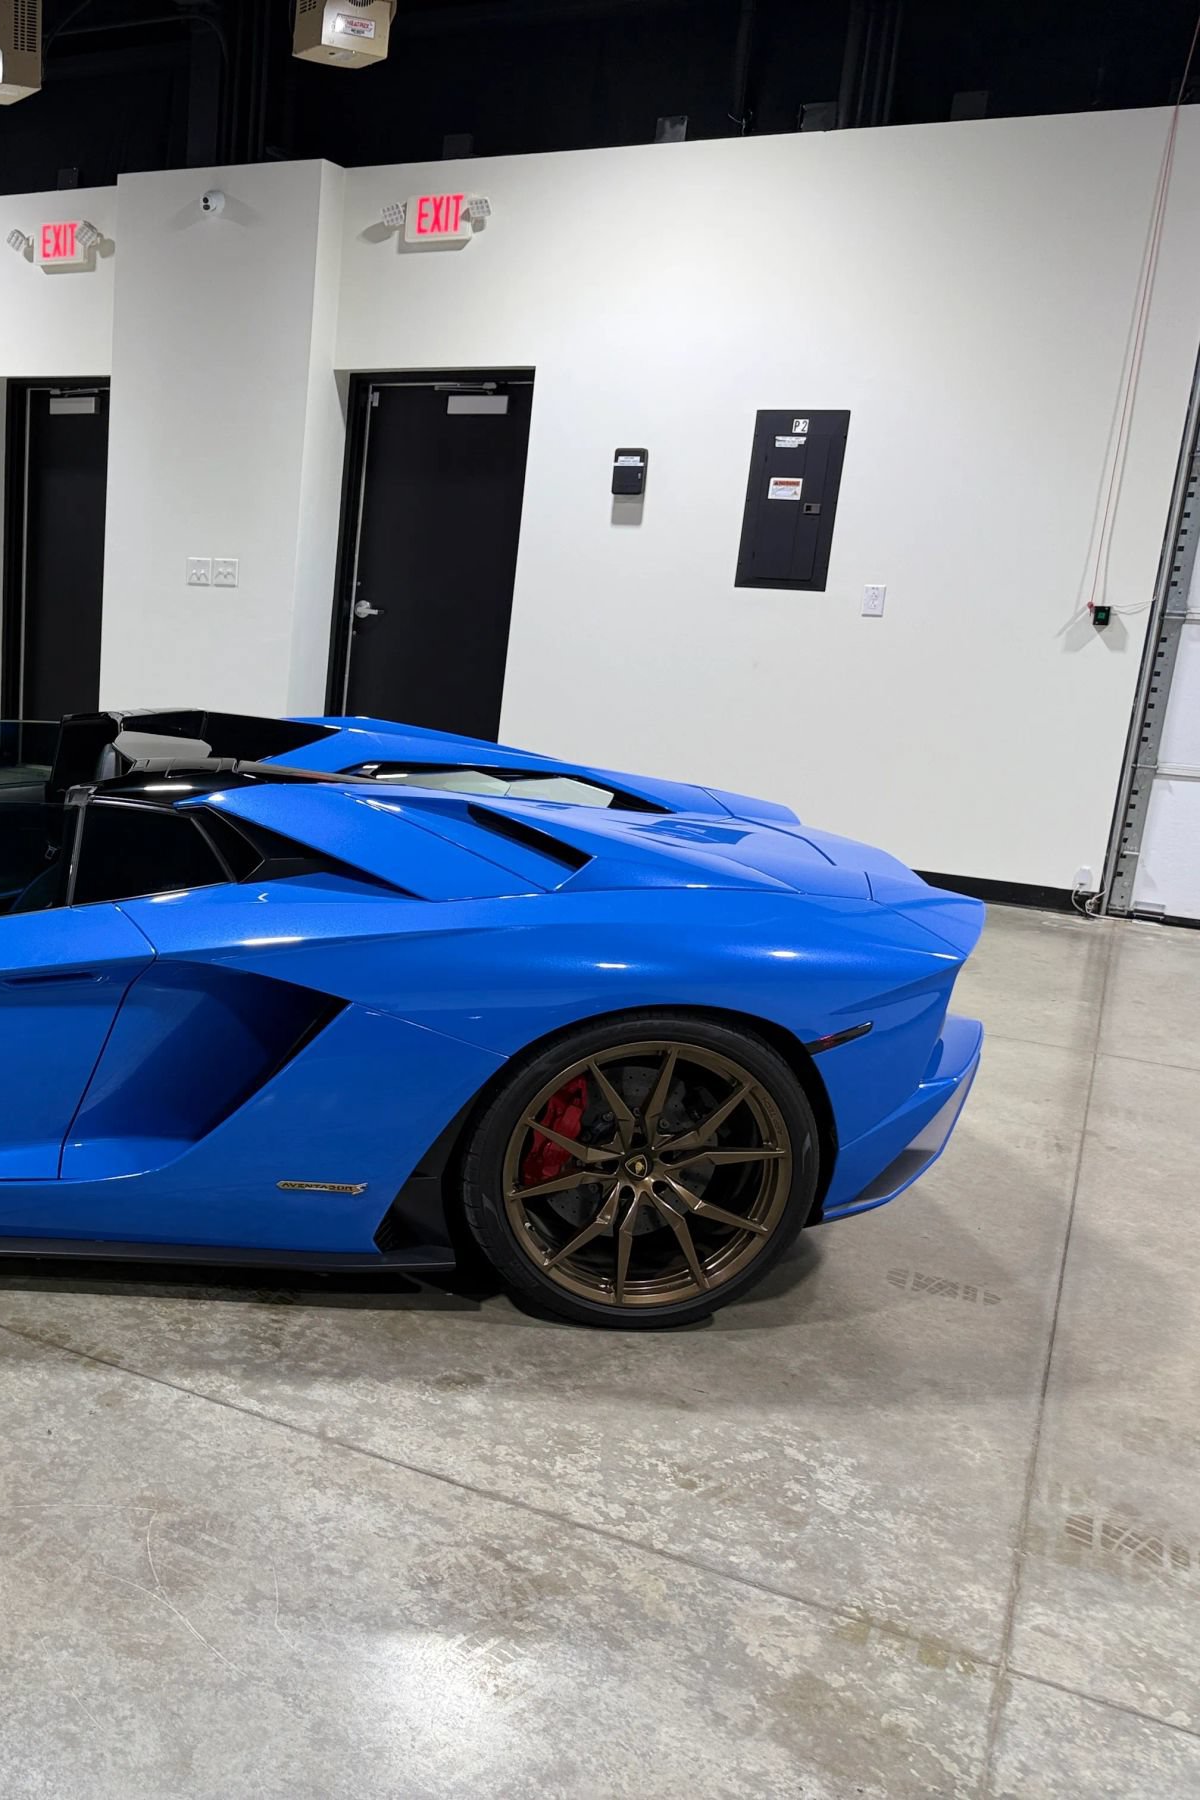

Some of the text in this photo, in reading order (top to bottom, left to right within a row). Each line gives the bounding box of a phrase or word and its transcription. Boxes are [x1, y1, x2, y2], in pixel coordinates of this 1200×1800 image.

[417, 194, 464, 234] EXIT
[42, 223, 78, 258] EXIT
[281, 1182, 355, 1192] AVENTADOR
